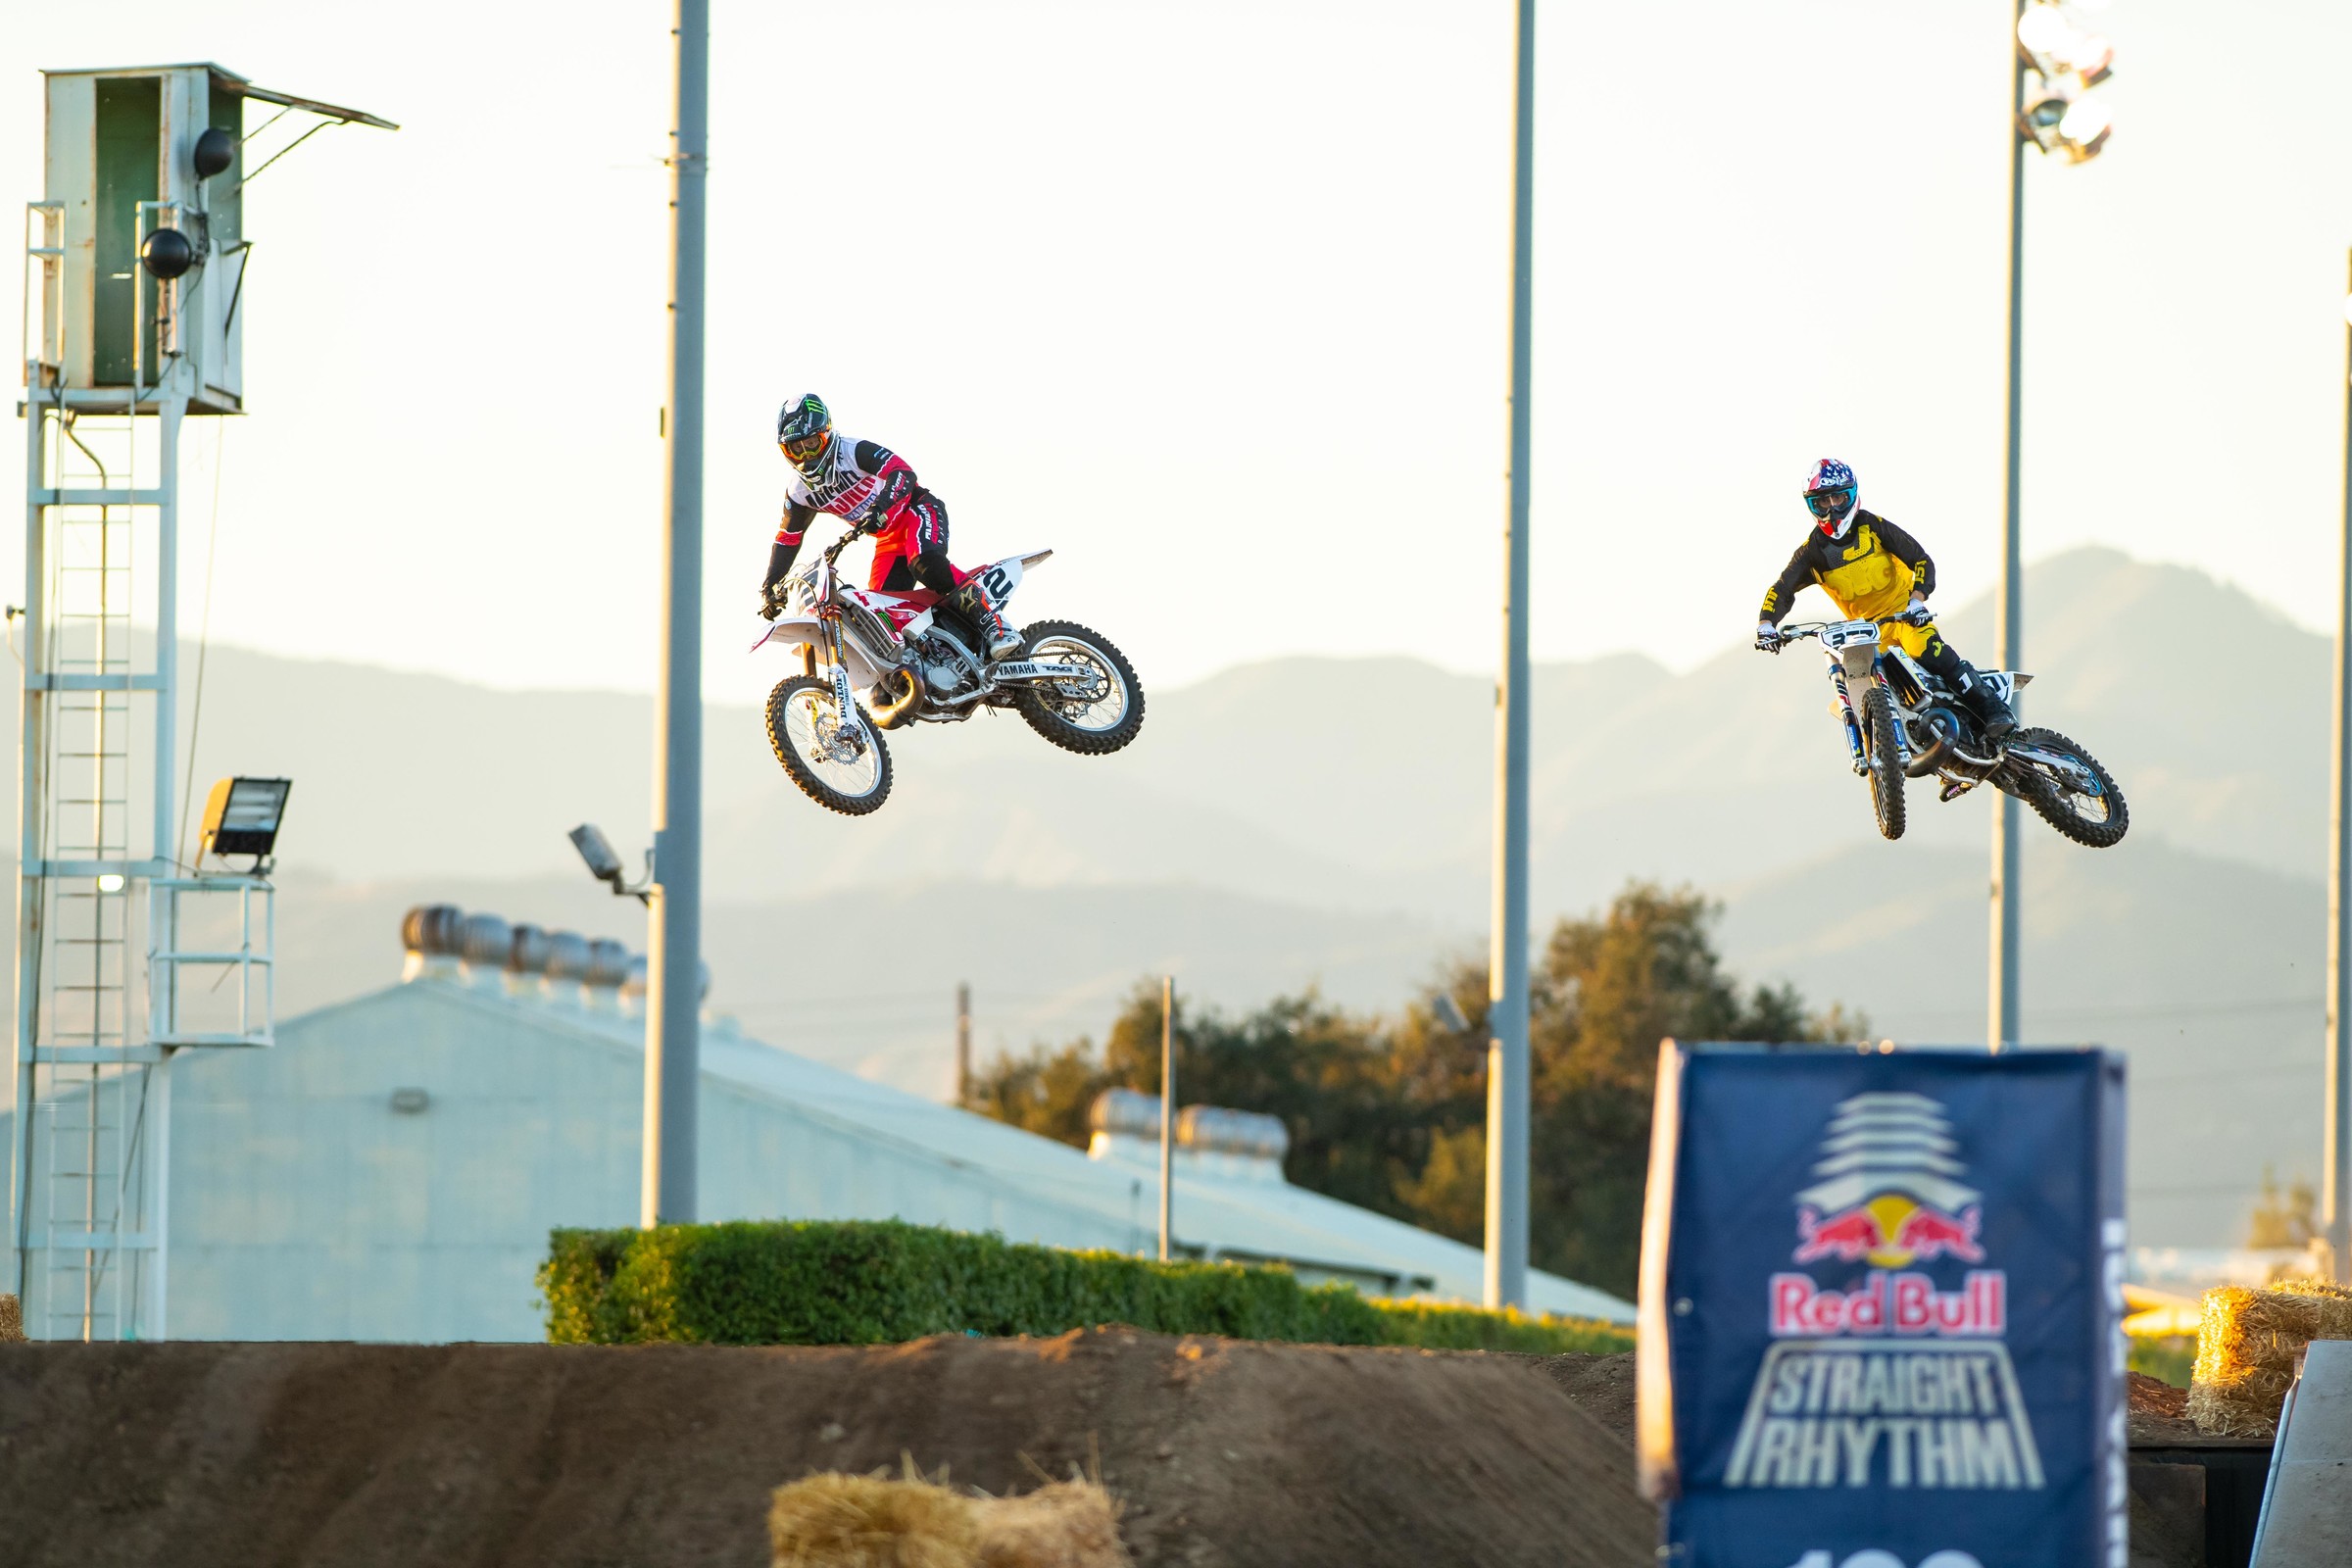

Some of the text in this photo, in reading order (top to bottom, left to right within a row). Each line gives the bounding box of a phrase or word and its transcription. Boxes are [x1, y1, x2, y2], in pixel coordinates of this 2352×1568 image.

[983, 567, 1014, 601] 2
[998, 663, 1039, 676] YAMAHA
[836, 675, 848, 718] DUNLOP
[1769, 1269, 2006, 1334] Red Bull
[1770, 1353, 1997, 1415] STRAIGHT
[1749, 1417, 2021, 1488] RHYTHM
